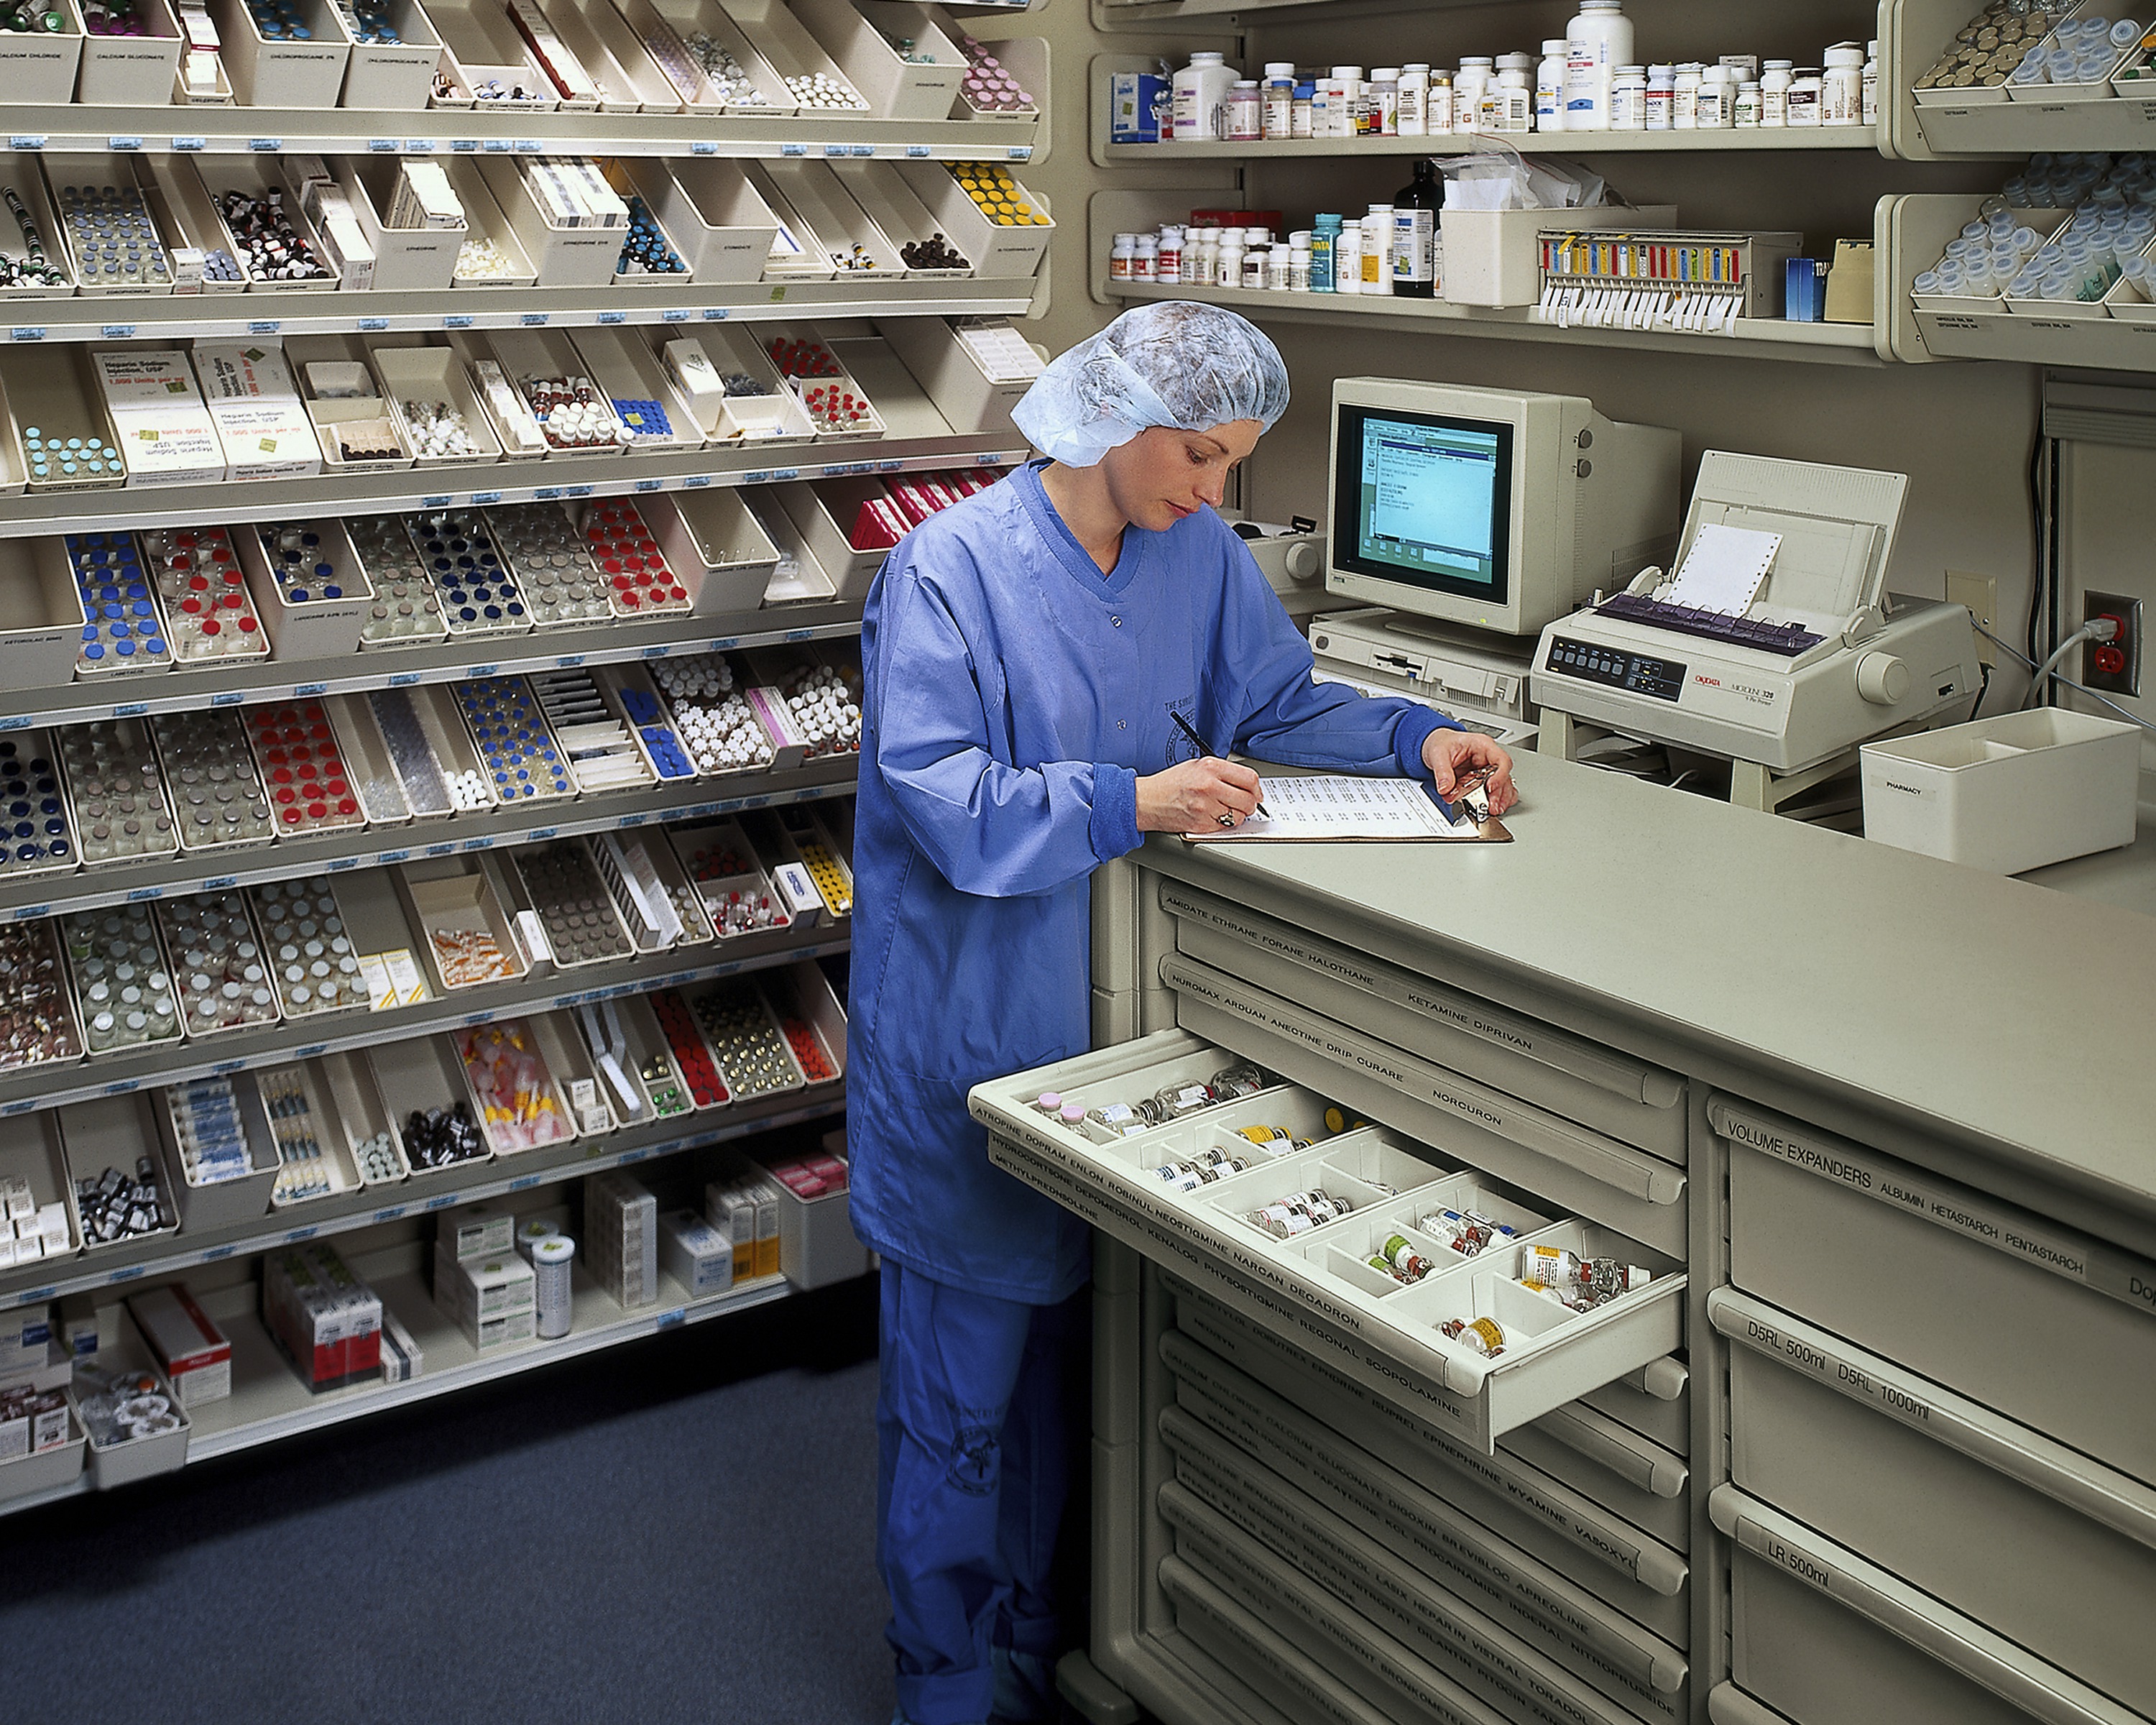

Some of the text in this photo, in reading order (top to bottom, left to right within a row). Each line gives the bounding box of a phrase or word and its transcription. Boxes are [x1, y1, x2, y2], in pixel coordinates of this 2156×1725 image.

[1194, 216, 1220, 228] Scotch
[1886, 781, 1922, 795] PHARMACY
[1166, 896, 1533, 1050] AMIDATE ETHRANE FORANE HALOTHANE KETAMINE DIPRIVAN
[1172, 974, 1502, 1126] NUROMAX ARDUAN ANECTINE DRIP CURARE NORCURON
[975, 1107, 1360, 1330] ATROPINE DOPRAM ENLON ROBINUL NEOSTIGMINE NARCAN DECADRON
[1728, 1120, 2084, 1275] VOLUME EXPANDERS ALBUMIN HETASTARCH PENTASTARCH
[1075, 1182, 1143, 1231] DEPOMEDROL
[1147, 1227, 1199, 1265] KENALOG
[1204, 1261, 1295, 1322] PHYSOSTIGMINE
[1299, 1317, 1361, 1360] REGONAL
[1365, 1356, 1461, 1418] SCOPOLAMINE
[1748, 1321, 1930, 1421] D5RL 500ml D5RL 1000ml
[1197, 1294, 1247, 1328] BRETYLOL
[1253, 1326, 1308, 1365] DOBUTREX
[1371, 1398, 1418, 1433] ISUPREL
[1423, 1430, 1502, 1486] EPINEPHRINE
[1506, 1482, 1567, 1527] WYAMINE
[1574, 1524, 1636, 1570] VASOXYL
[1266, 1416, 1313, 1453] CALCIUM
[1317, 1450, 1383, 1500] GLUCONATE
[1388, 1498, 1437, 1535] DIGOXIN
[1441, 1532, 1511, 1582] BREVIBLOC
[1516, 1582, 1589, 1637] APREOLINE
[1769, 1540, 1829, 1588] LR 500ml
[1302, 1520, 1370, 1576] DROPERIDOL
[1376, 1572, 1408, 1601] LASIX
[1413, 1598, 1467, 1642] HEPARIN
[1528, 1677, 1590, 1725] TORADOL
[1318, 1618, 1376, 1664] ATROVENT
[1385, 1517, 1409, 1540] KCL
[1413, 1536, 1503, 1603] PROCAINAMIDE
[1508, 1601, 1565, 1644] INDERAL
[1570, 1641, 1675, 1718] NITROPRUSSIDE
[1416, 1624, 1472, 1669] DILANTIN
[1477, 1667, 1526, 1708] PITOCIN
